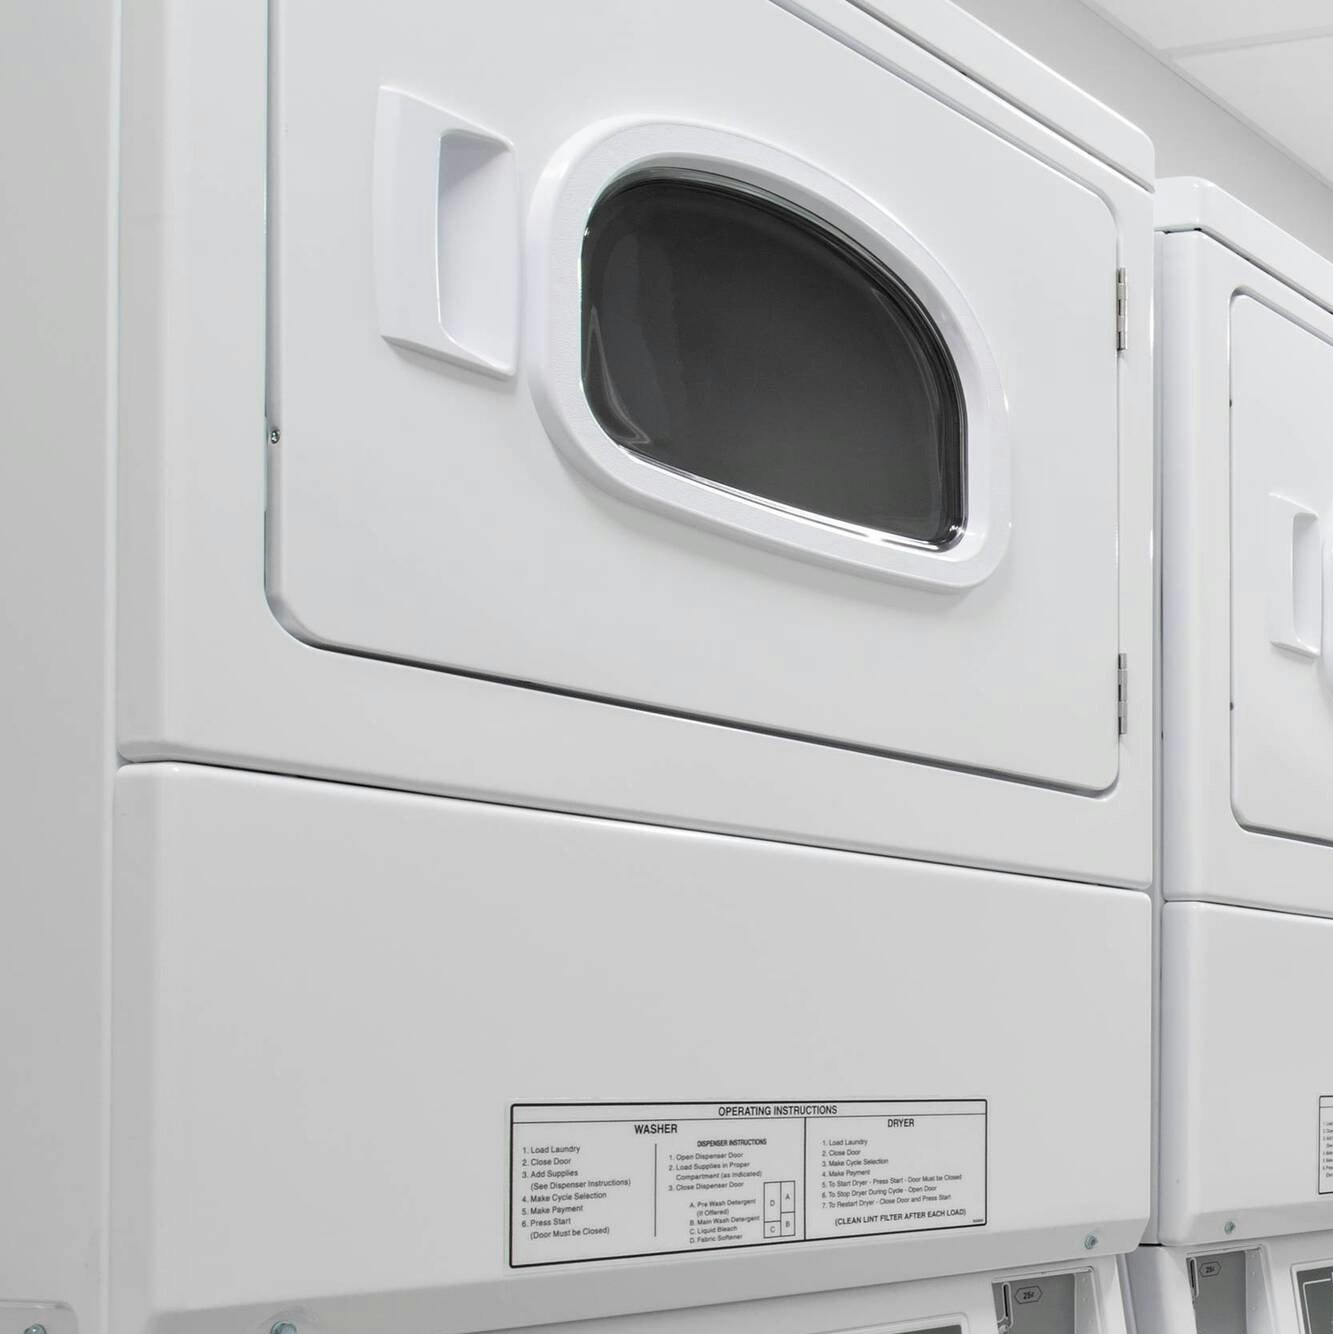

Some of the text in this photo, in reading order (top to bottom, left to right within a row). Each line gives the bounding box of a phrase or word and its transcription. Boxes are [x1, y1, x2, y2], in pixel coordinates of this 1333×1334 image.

[718, 1105, 837, 1117] OPERATING INSTRUCTIONS
[887, 1119, 914, 1128] DRYER
[635, 1124, 677, 1134] WASHER
[530, 1146, 549, 1154] Load
[551, 1146, 580, 1154] Laundry
[530, 1158, 552, 1166] Close
[547, 1170, 578, 1178] Supplies
[530, 1179, 631, 1191] (See Dispenser Instructions)
[552, 1194, 572, 1202] Cycle
[574, 1192, 607, 1200] Selection
[552, 1205, 583, 1214] Payment
[835, 1217, 862, 1227] (CLEAN
[880, 1213, 903, 1222] FILTER
[904, 1211, 926, 1220] AFTER
[928, 1210, 945, 1218] EACH
[947, 1208, 966, 1217] LOAD)
[530, 1232, 551, 1240] (Door
[583, 1227, 609, 1235] Closed)
